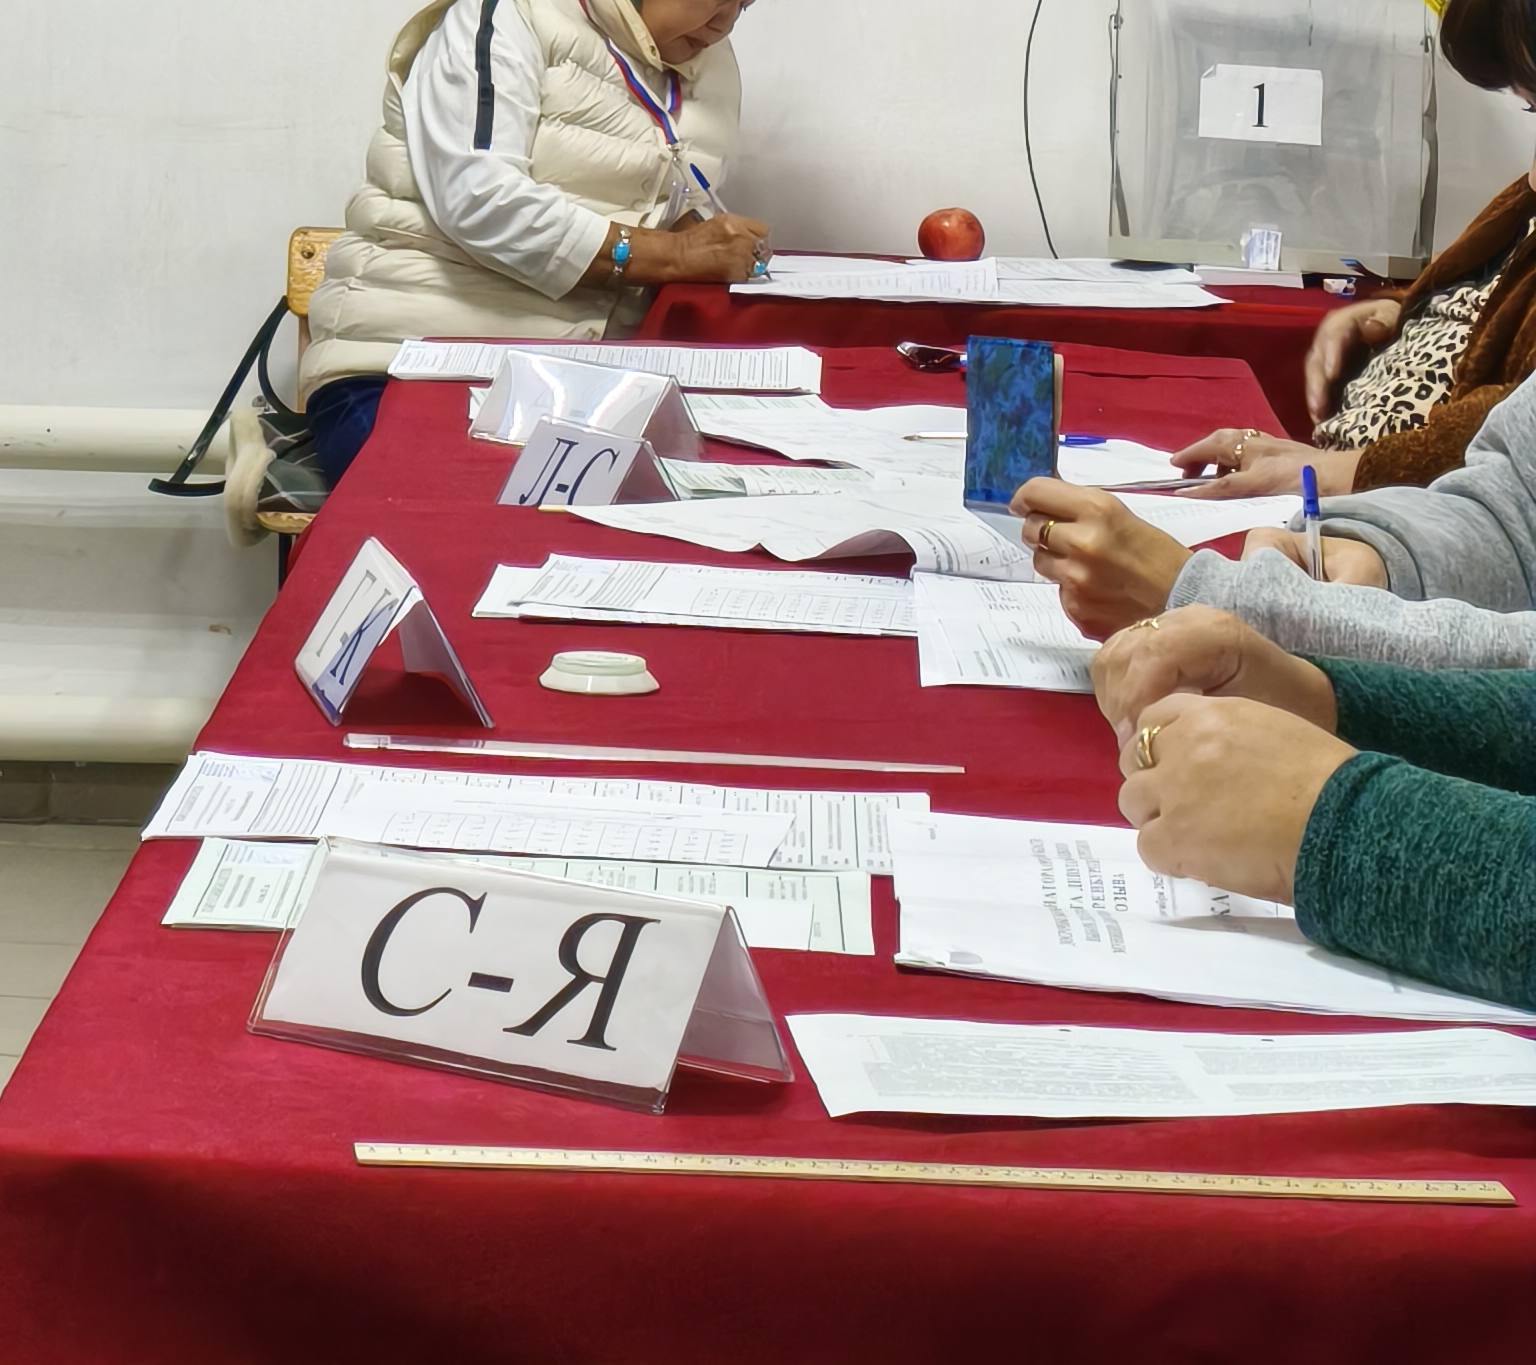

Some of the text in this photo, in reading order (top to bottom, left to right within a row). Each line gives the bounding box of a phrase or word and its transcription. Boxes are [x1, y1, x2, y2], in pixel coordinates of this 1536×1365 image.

[1251, 82, 1269, 128] 1
[518, 437, 621, 506] Л-С
[360, 885, 662, 1053] С-Я
